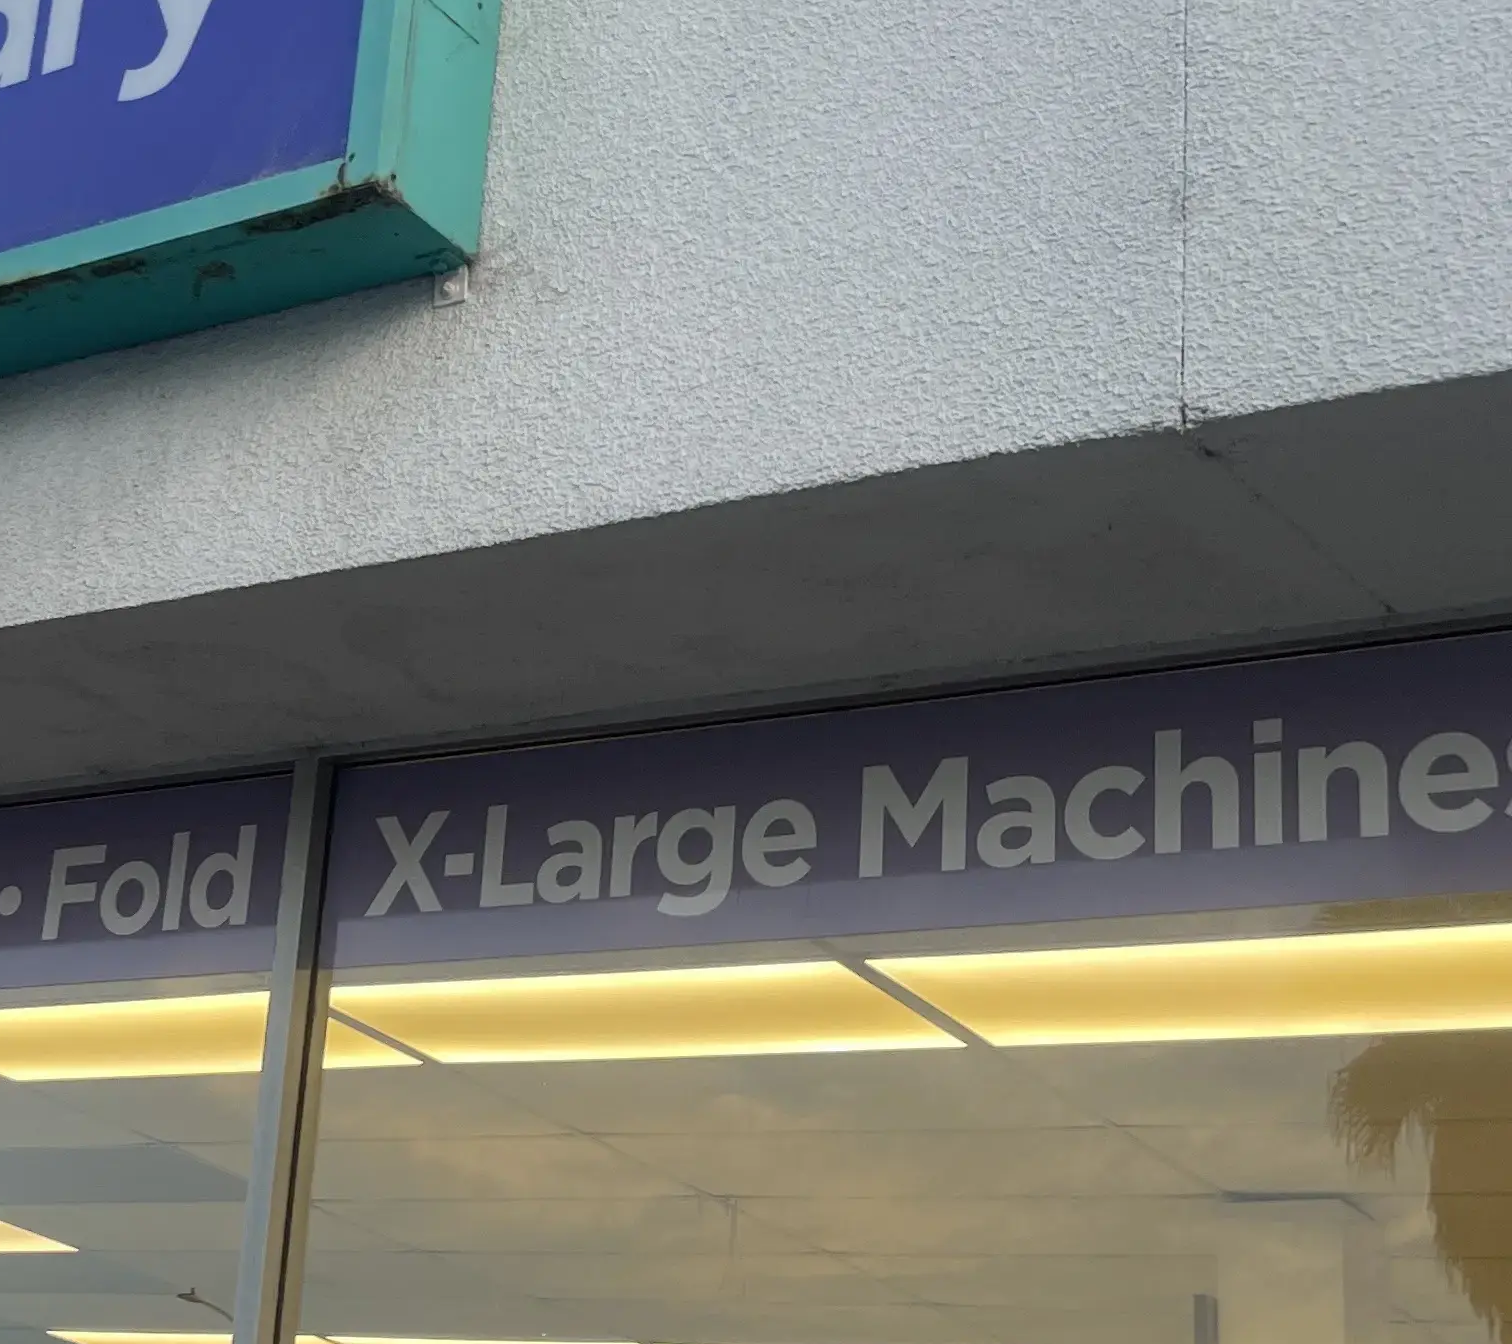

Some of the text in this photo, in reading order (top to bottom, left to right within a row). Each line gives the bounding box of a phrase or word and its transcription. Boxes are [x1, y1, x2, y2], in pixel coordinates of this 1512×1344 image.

[41, 824, 258, 941] Fold
[365, 718, 1512, 918] X-Large Machine
